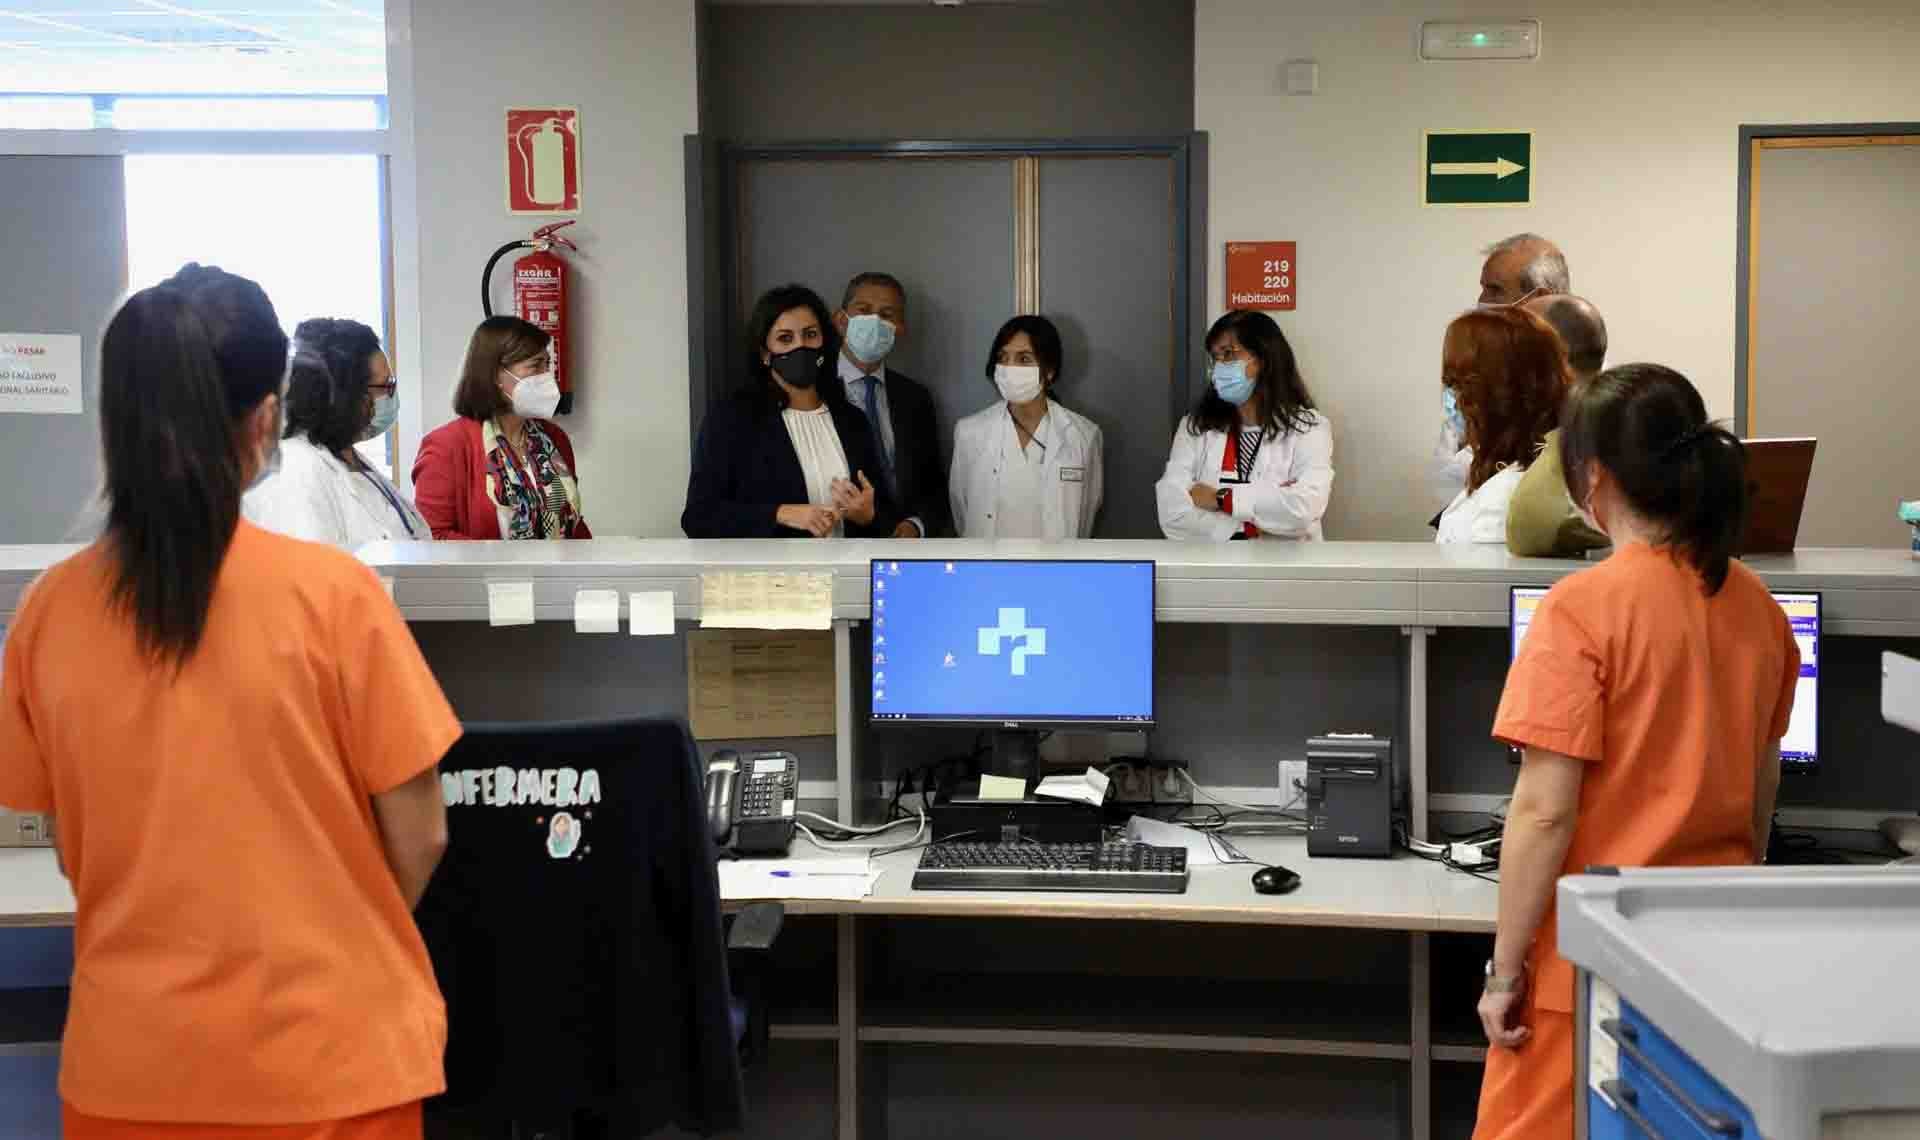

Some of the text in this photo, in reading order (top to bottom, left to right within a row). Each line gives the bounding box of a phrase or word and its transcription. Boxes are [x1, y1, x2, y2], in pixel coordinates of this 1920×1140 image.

[1263, 260, 1289, 273] 219
[1263, 276, 1289, 289] 220
[1231, 292, 1290, 305] Habitación
